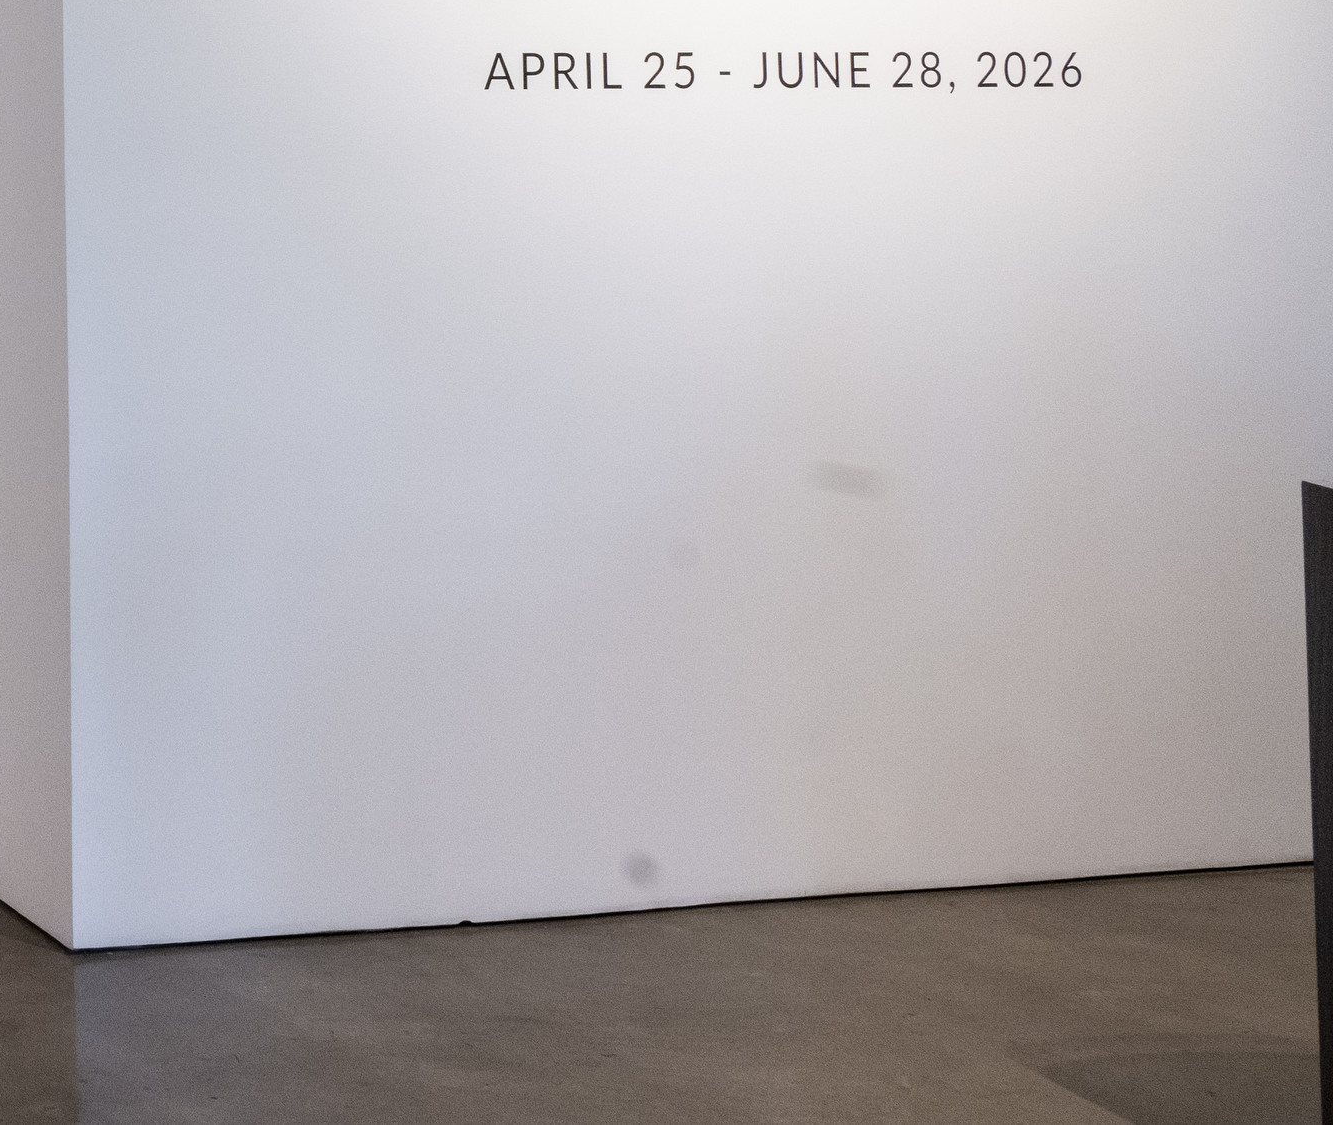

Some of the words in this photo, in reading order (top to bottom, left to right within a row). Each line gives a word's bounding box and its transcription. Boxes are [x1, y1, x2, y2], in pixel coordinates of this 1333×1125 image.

[484, 52, 622, 90] APRIL
[644, 52, 695, 89] 25
[753, 52, 871, 89] JUNE
[892, 51, 957, 94] 28,
[977, 51, 1082, 88] 2026
